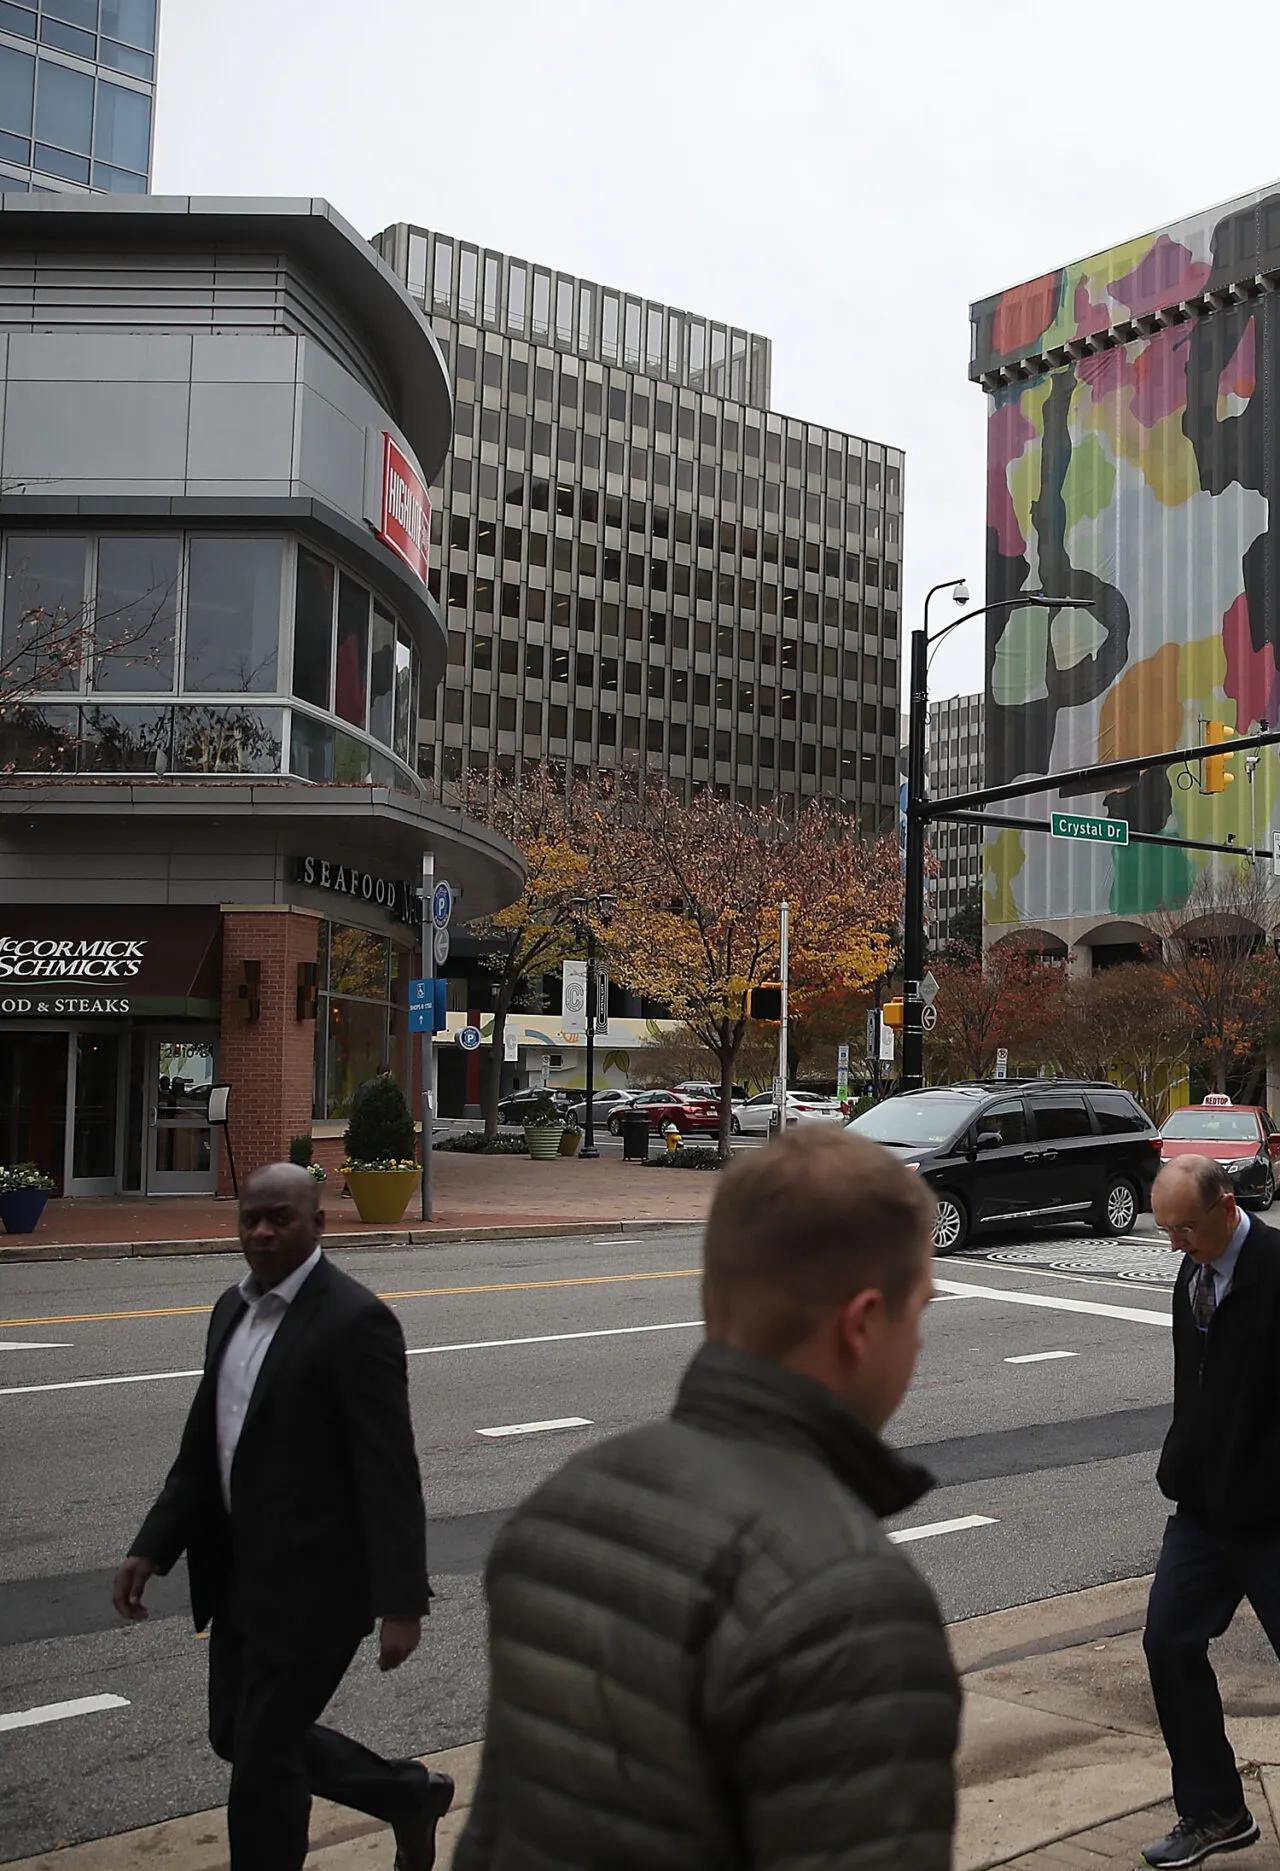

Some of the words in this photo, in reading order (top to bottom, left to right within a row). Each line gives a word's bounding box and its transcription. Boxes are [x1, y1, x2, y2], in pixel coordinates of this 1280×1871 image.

[1059, 819, 1103, 836] Crystal
[1107, 824, 1121, 838] Dr
[304, 856, 397, 908] SEAFOOD
[37, 1001, 49, 1012] &
[55, 999, 130, 1013] STEAKS
